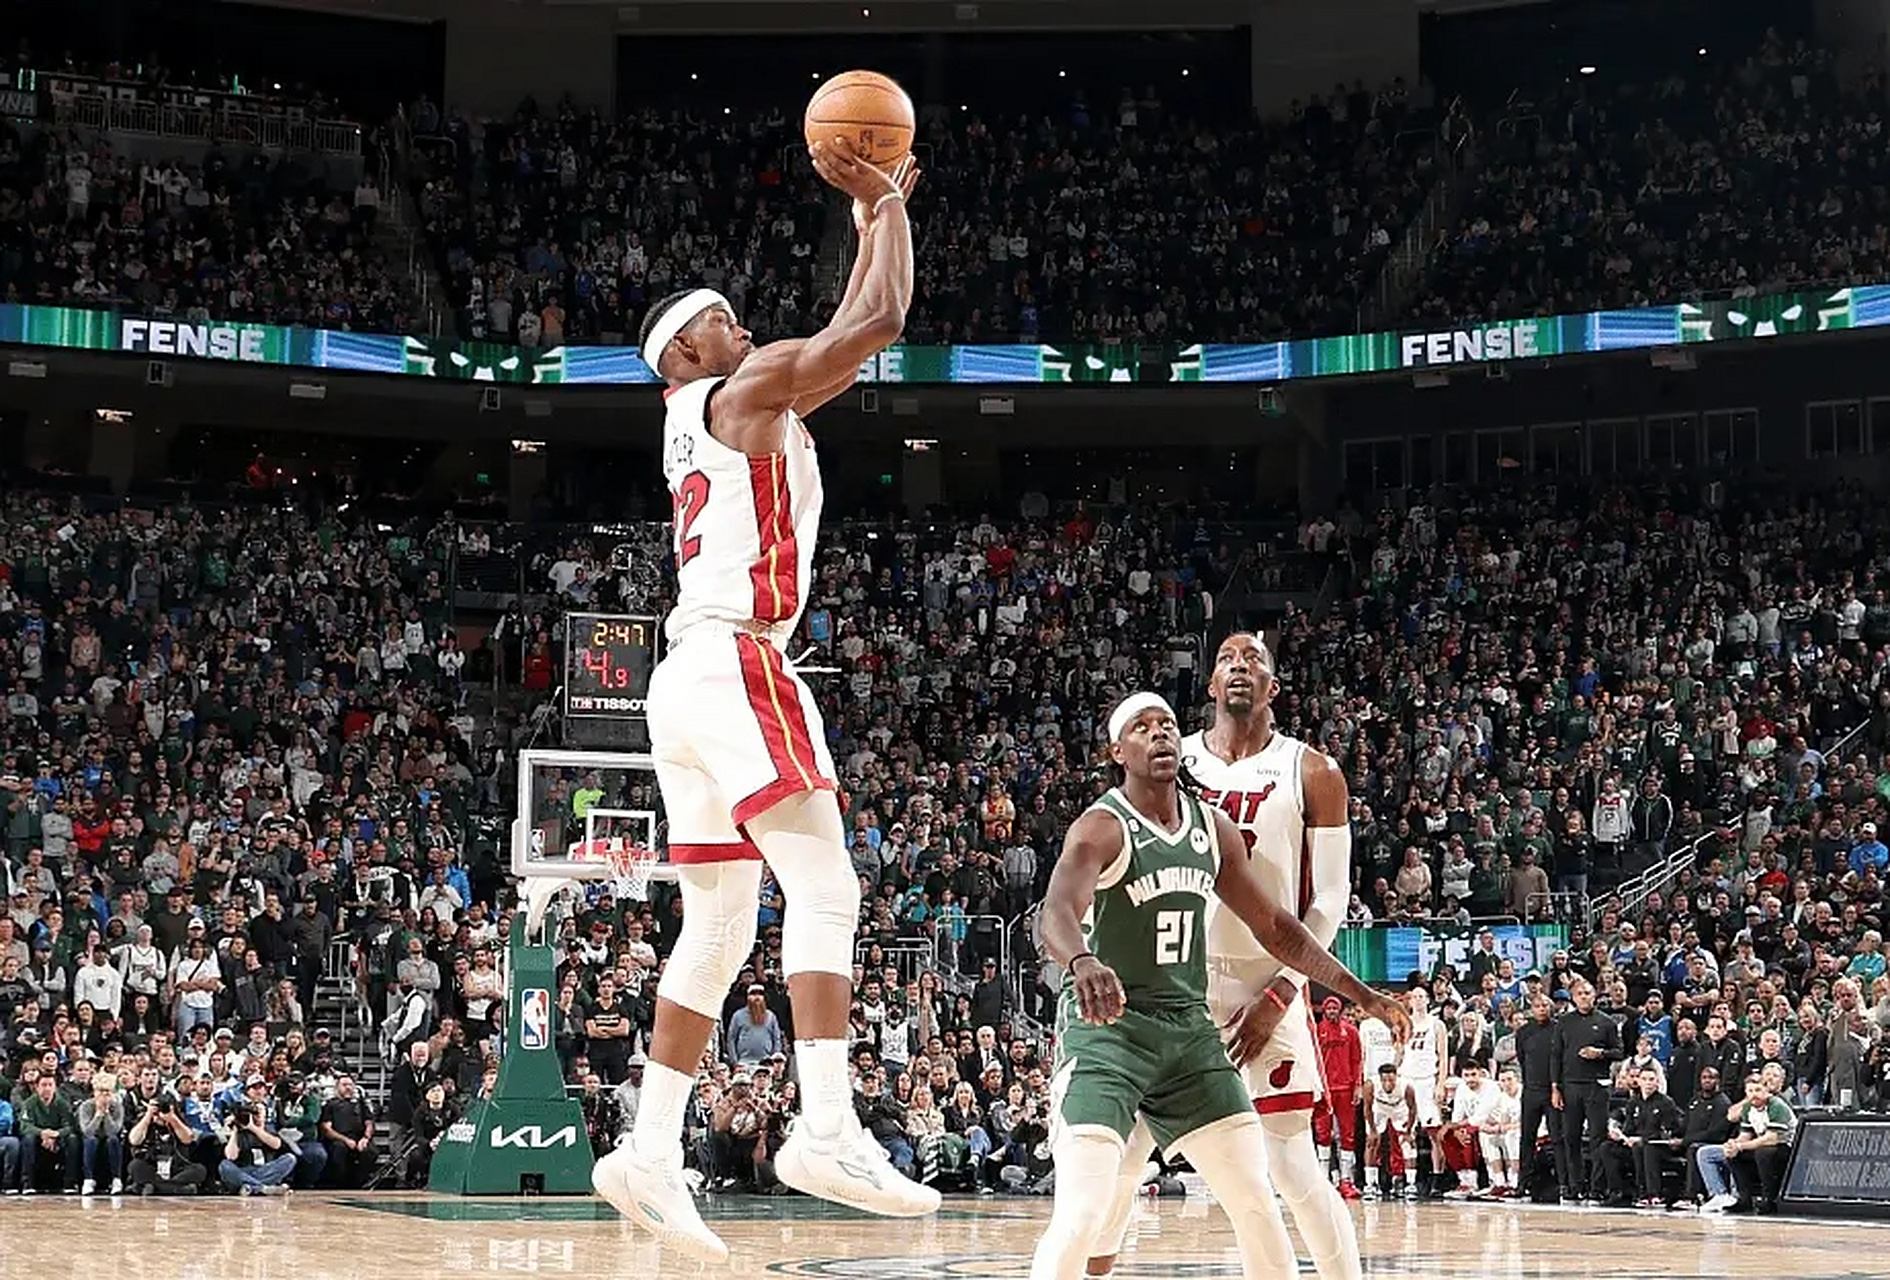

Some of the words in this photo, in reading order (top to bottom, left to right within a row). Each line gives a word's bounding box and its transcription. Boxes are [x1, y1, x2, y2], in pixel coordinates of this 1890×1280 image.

[122, 319, 264, 361] FENSE
[1402, 323, 1538, 366] FENSE
[672, 469, 711, 571] 2
[594, 622, 644, 646] 2:47
[593, 697, 648, 711] TISSOT
[1156, 911, 1194, 964] 21
